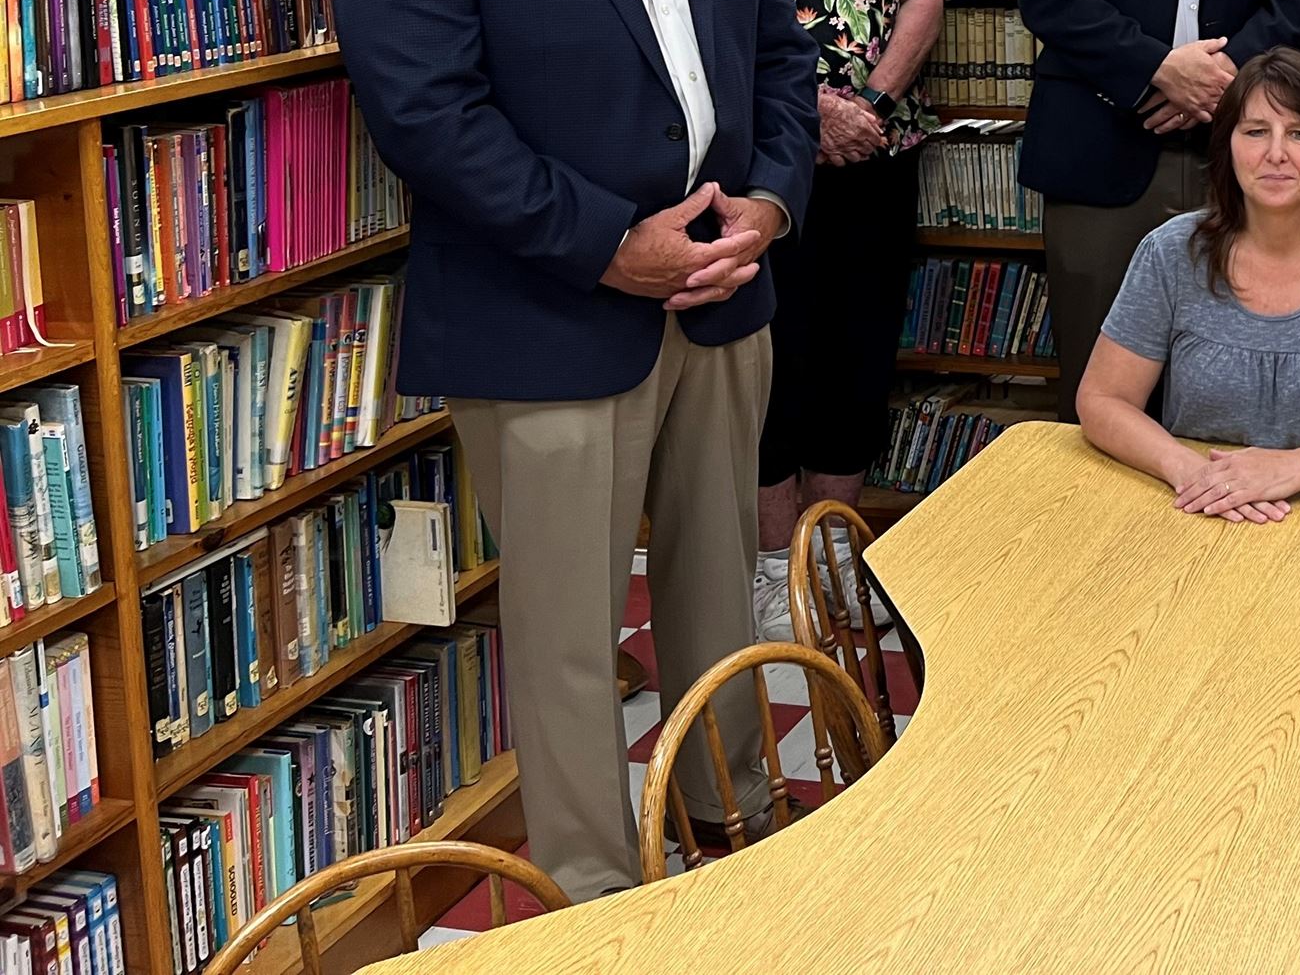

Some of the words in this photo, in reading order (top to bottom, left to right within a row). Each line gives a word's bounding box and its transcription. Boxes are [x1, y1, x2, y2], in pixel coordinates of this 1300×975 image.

[131, 179, 141, 250] SOUND
[286, 368, 297, 401] AMY
[185, 403, 196, 453] Ramona's
[189, 454, 198, 485] World
[228, 865, 238, 916] SCHOOLED
